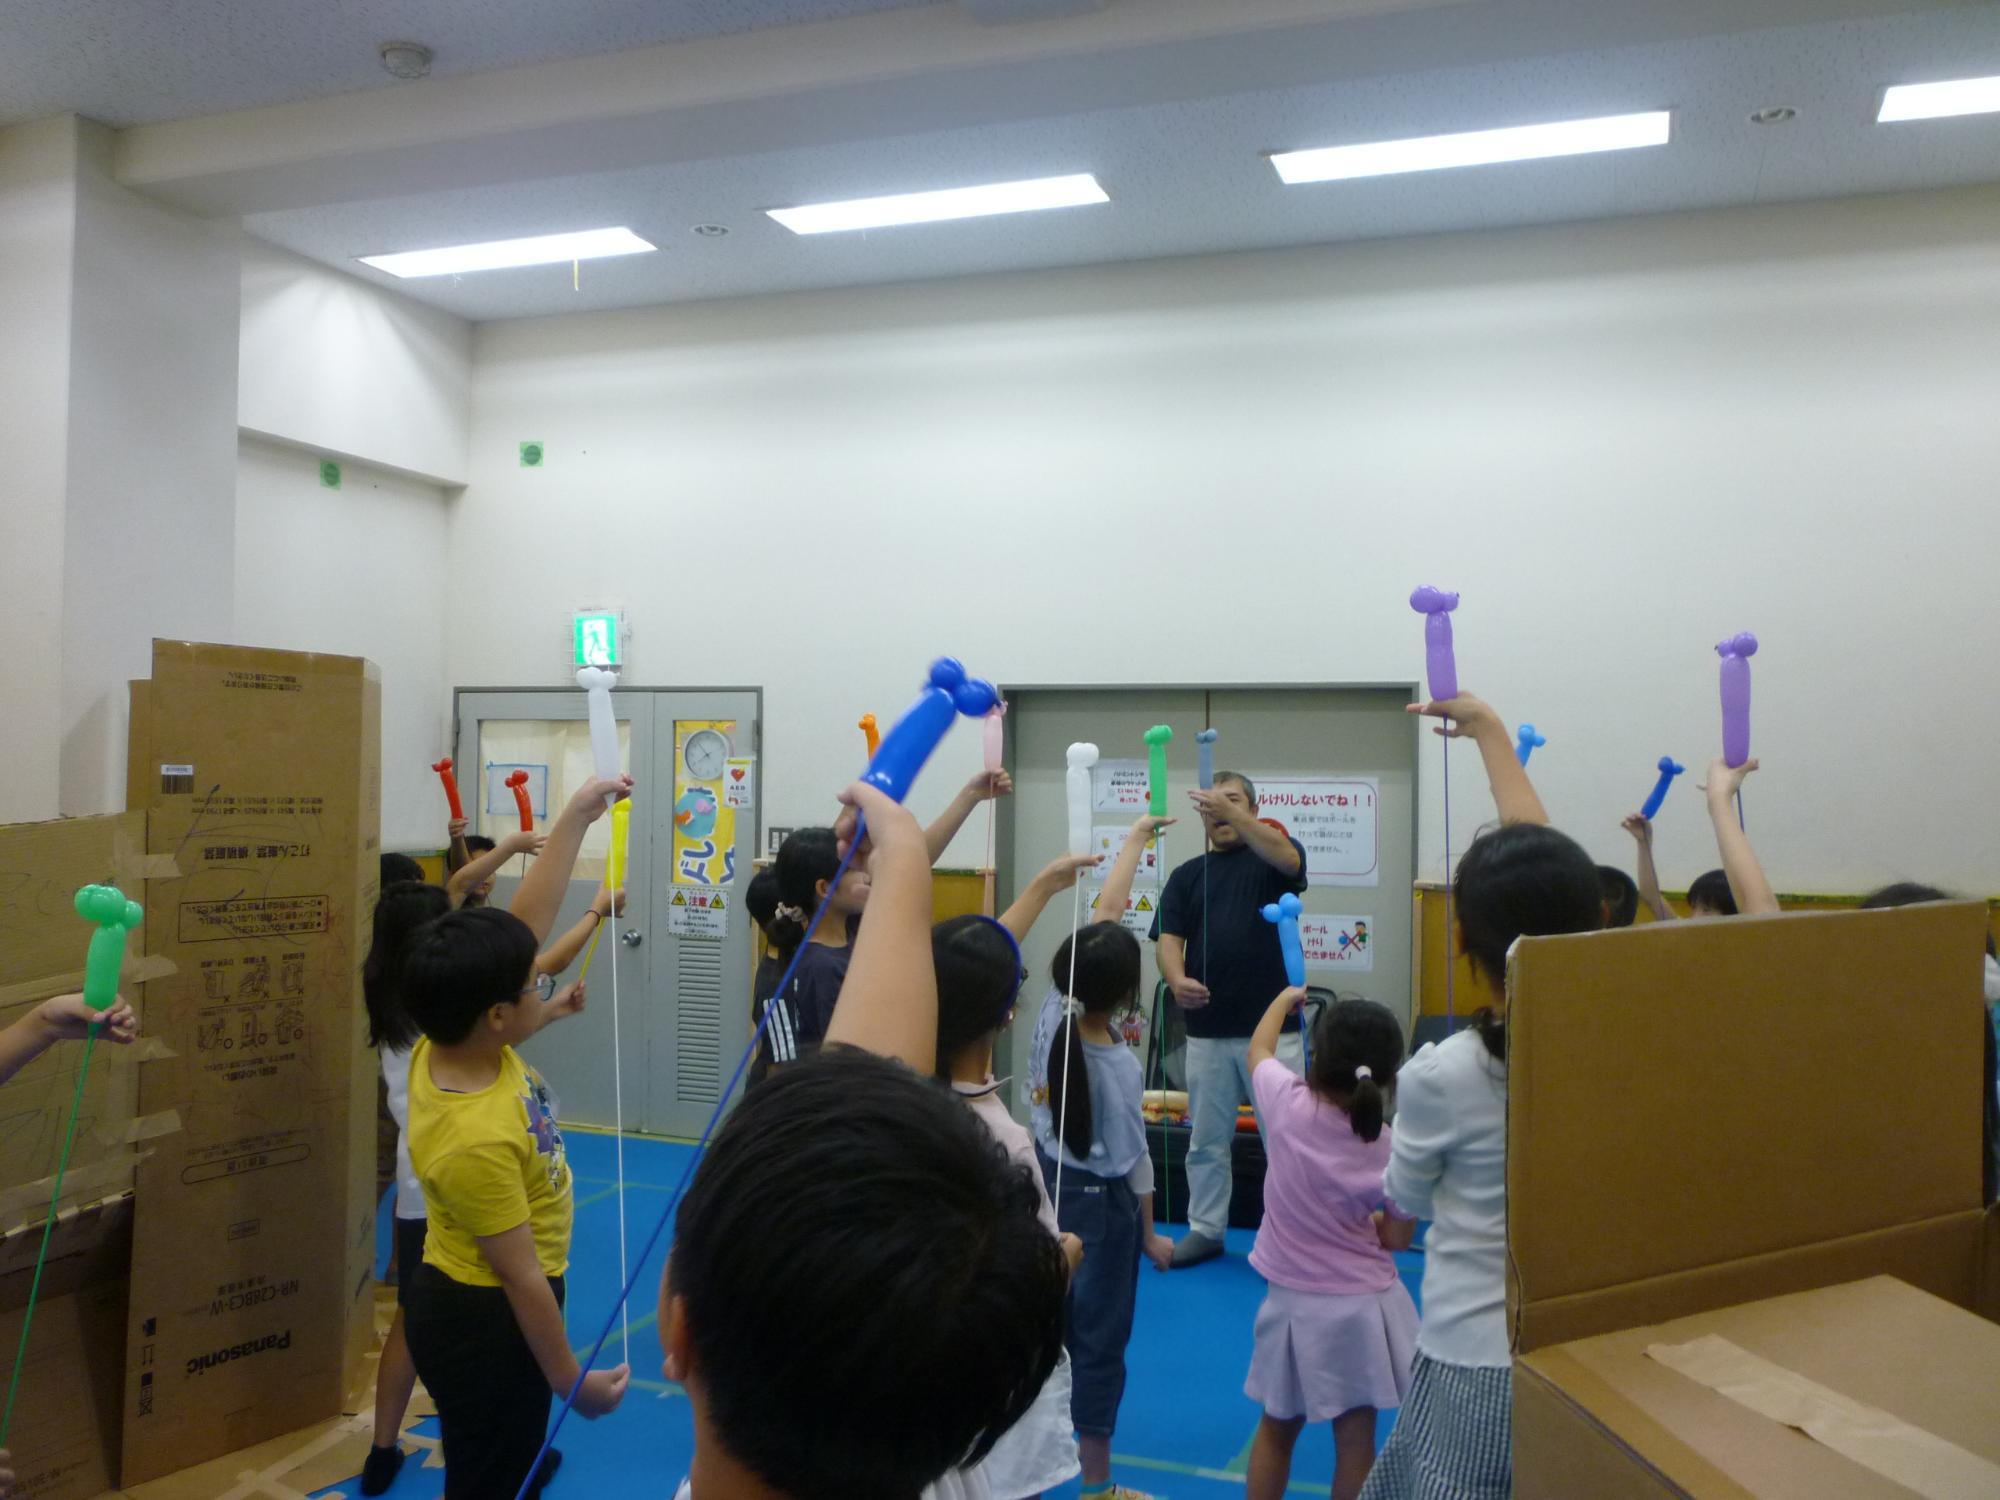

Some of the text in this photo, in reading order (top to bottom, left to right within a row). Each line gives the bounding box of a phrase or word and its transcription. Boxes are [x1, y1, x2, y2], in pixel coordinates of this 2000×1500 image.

[688, 895, 708, 907] 注意
[1302, 923, 1329, 935] ボール
[186, 1330, 290, 1375] Panasonic
